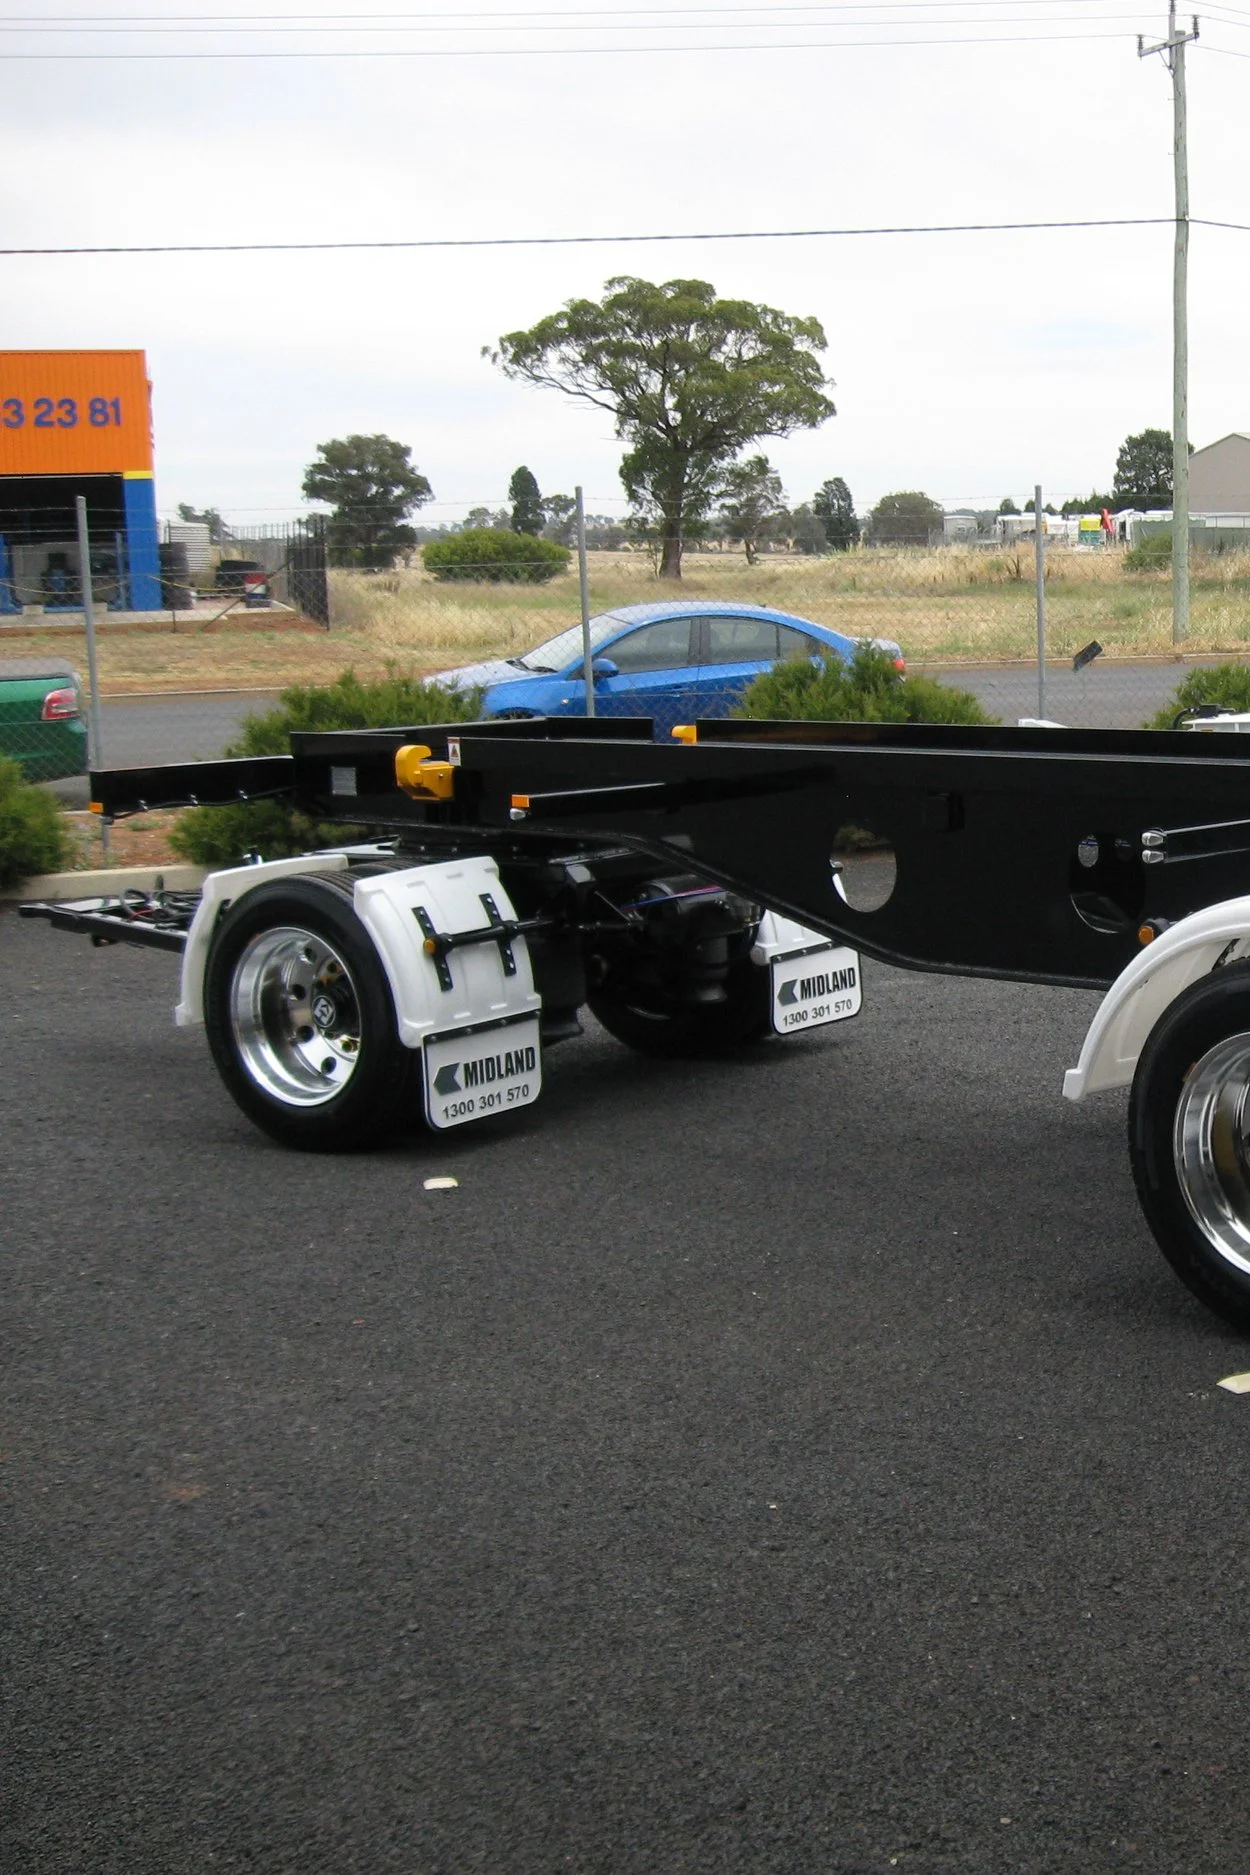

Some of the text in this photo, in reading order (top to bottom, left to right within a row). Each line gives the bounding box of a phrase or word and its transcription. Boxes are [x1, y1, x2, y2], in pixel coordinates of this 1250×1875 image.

[33, 397, 78, 428] 23
[88, 397, 121, 427] 81
[800, 967, 857, 1001] MIDLAND
[783, 999, 853, 1027] 1300 301 570
[463, 1046, 535, 1089] MIDLAND
[443, 1084, 530, 1119] 1300 301 570
